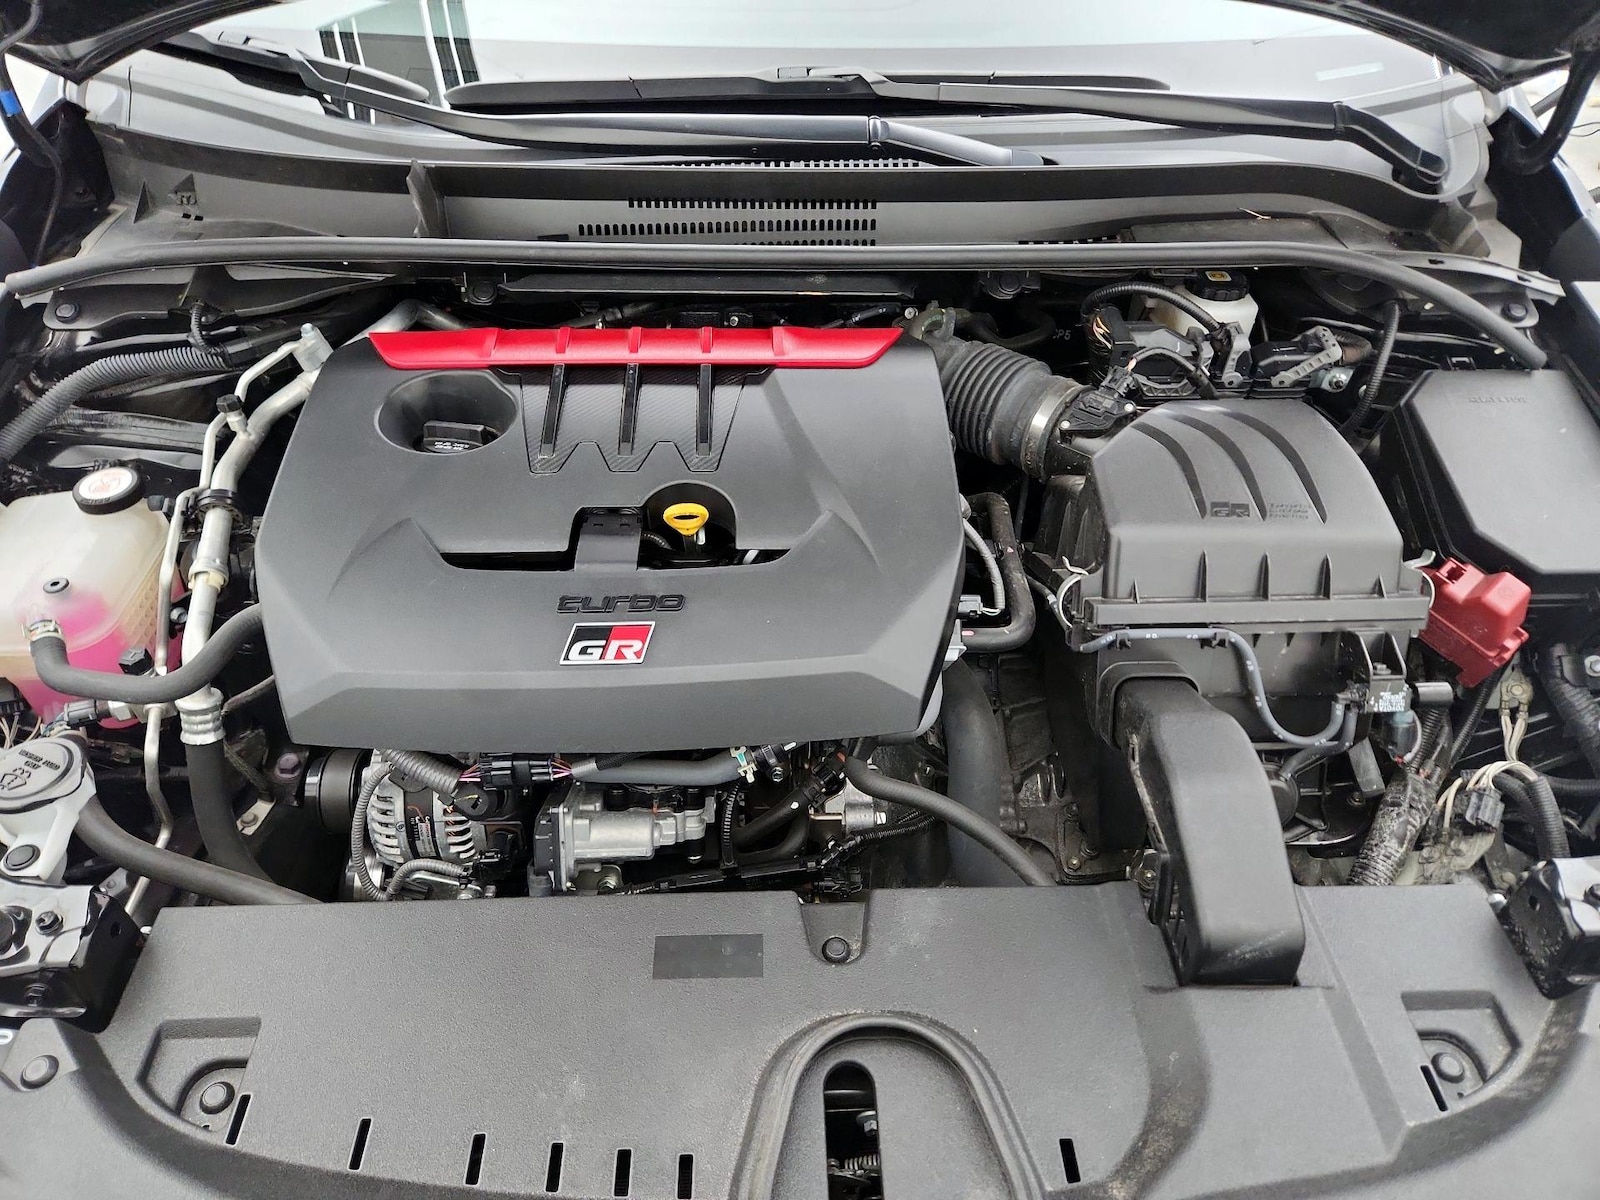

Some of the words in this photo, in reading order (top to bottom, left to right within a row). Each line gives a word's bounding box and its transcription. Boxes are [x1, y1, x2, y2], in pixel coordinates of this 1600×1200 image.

[1211, 505, 1250, 518] GR
[557, 594, 685, 613] turbo
[567, 639, 644, 661] GR
